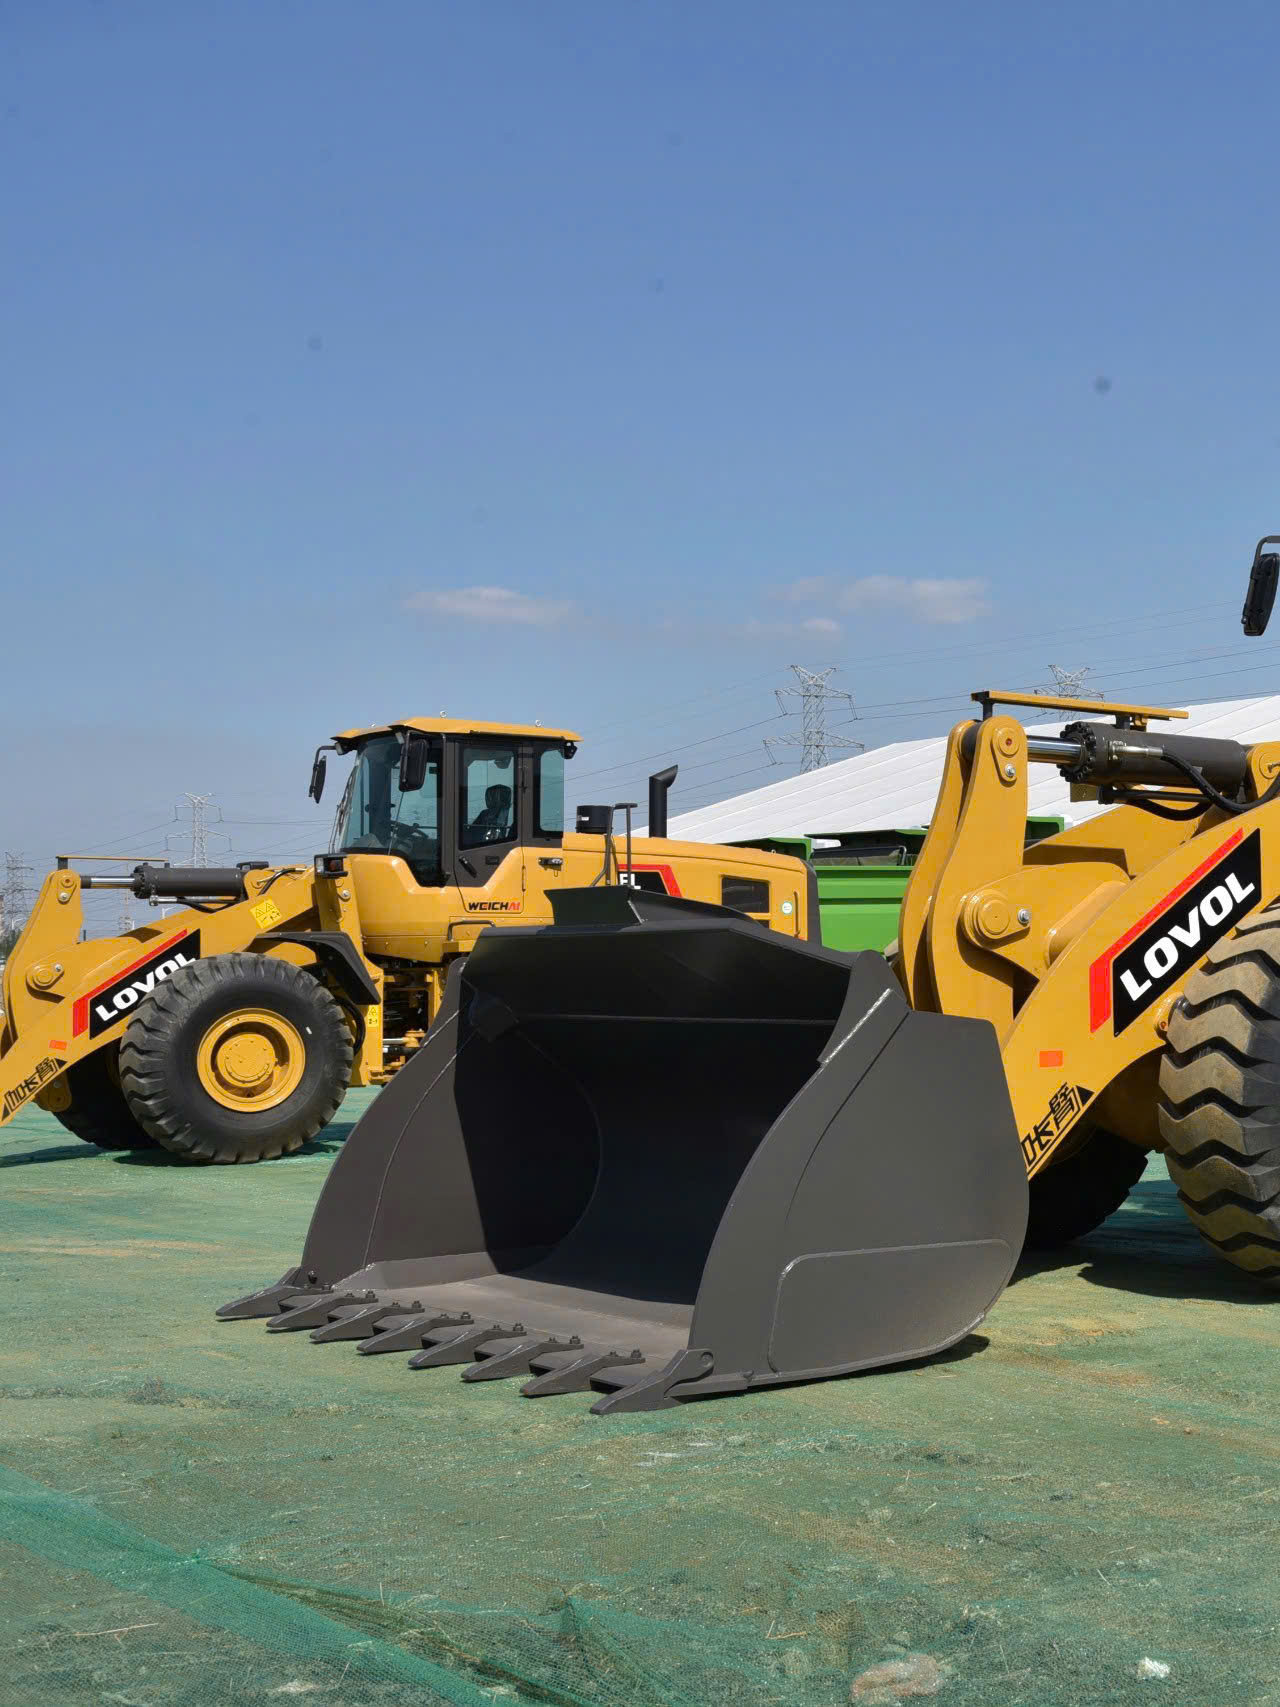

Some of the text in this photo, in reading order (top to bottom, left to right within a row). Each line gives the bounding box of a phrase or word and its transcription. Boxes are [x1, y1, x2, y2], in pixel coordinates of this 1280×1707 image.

[619, 873, 641, 890] FL
[468, 901, 521, 911] WEICHAI
[1120, 872, 1256, 1002] LOVOL
[95, 952, 197, 1022] LOVOL
